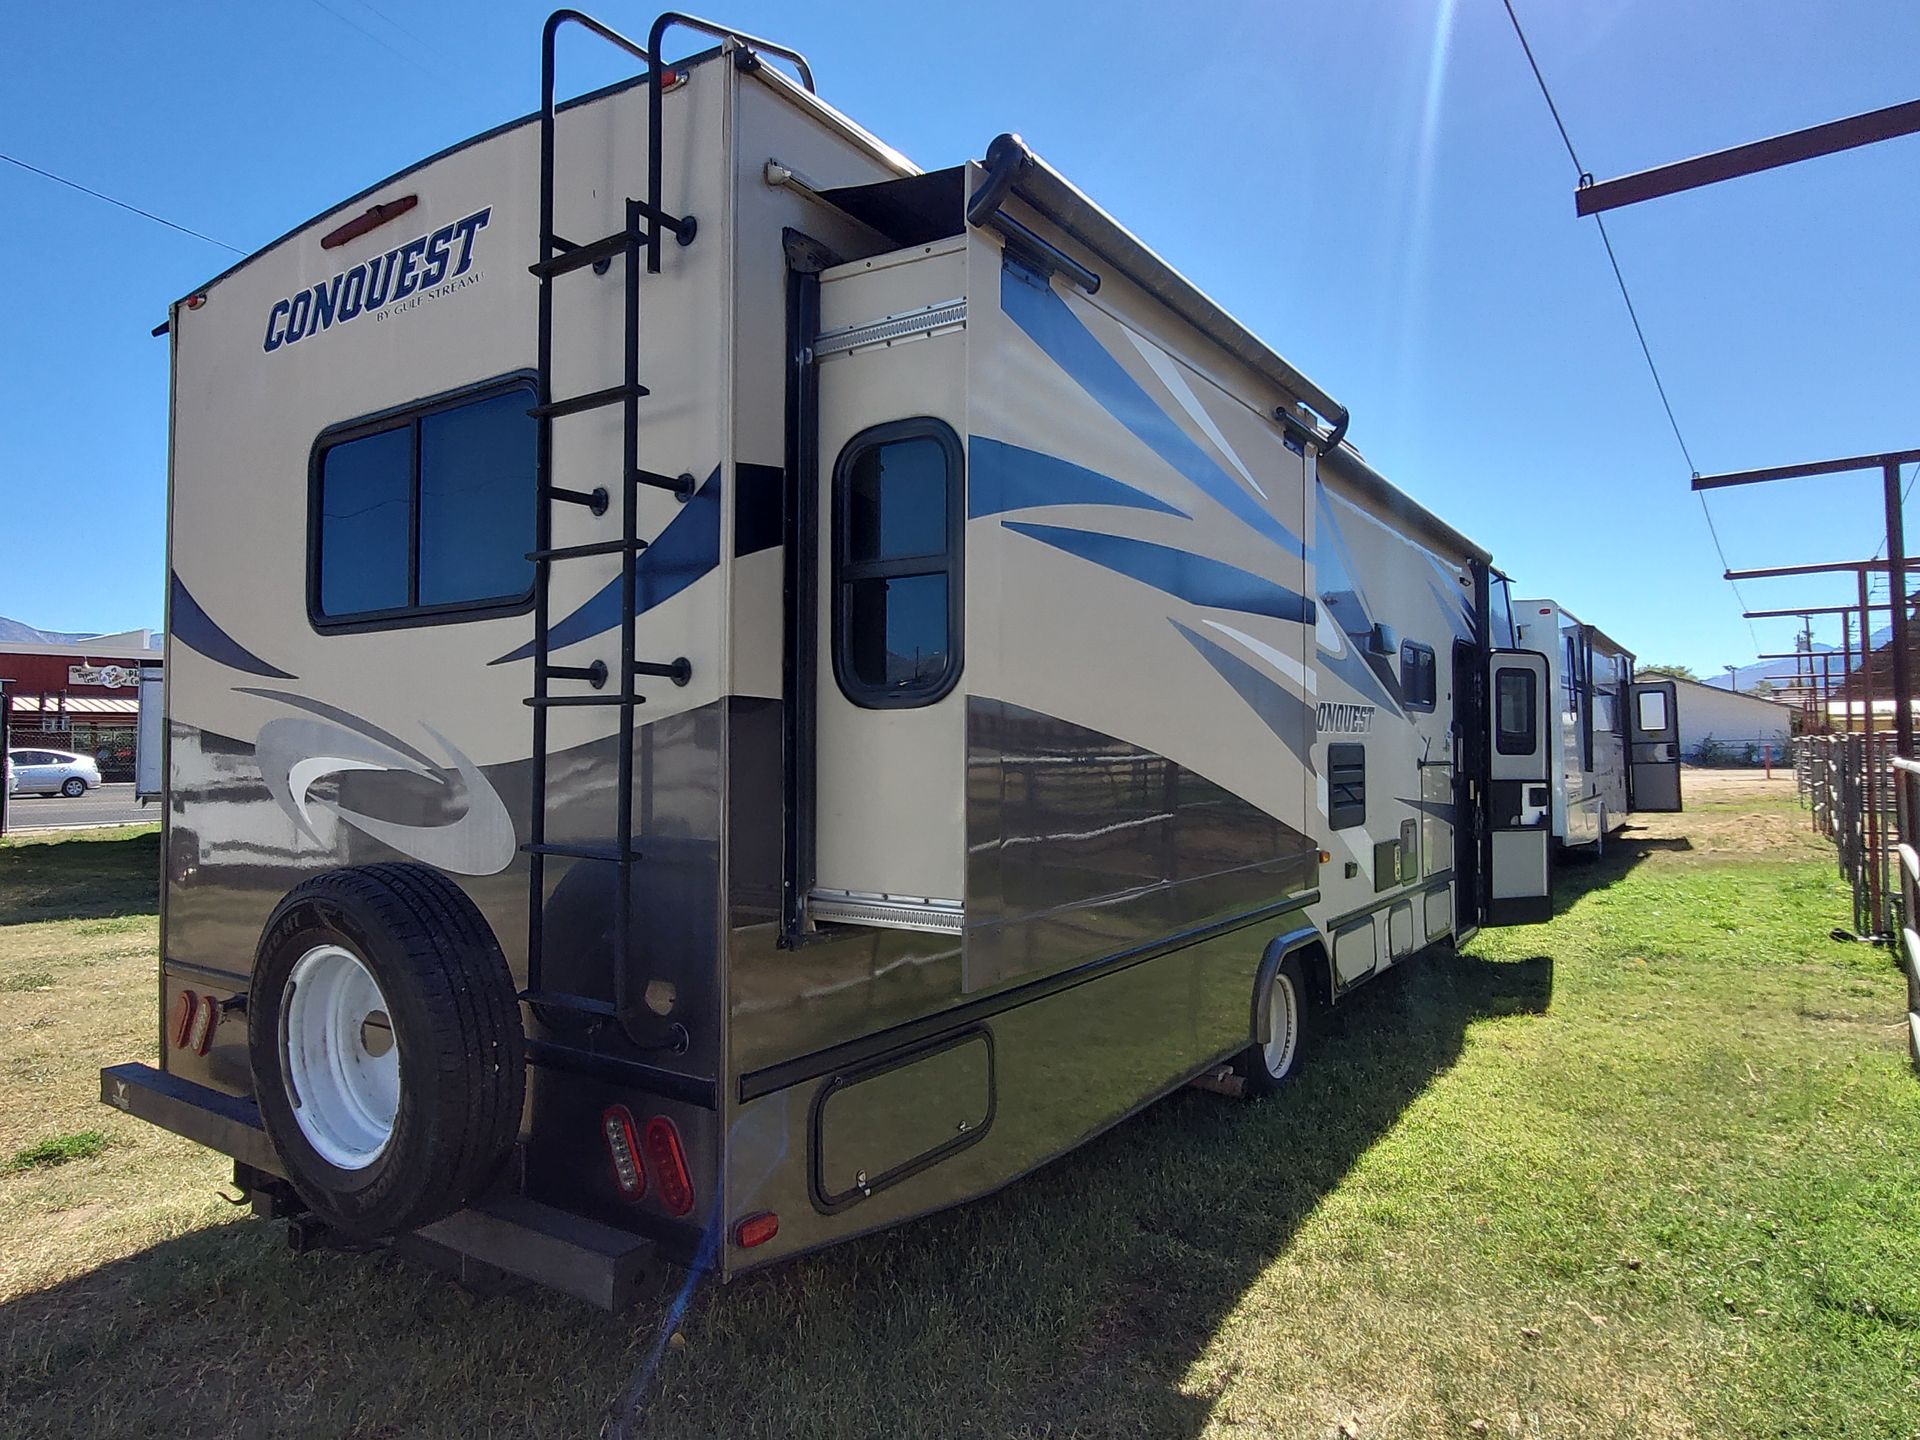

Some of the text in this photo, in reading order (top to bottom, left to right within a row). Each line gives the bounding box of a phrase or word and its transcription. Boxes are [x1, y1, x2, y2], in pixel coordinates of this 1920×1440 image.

[263, 205, 493, 353] CONQUEST
[376, 272, 481, 322] BY GULF STREAM
